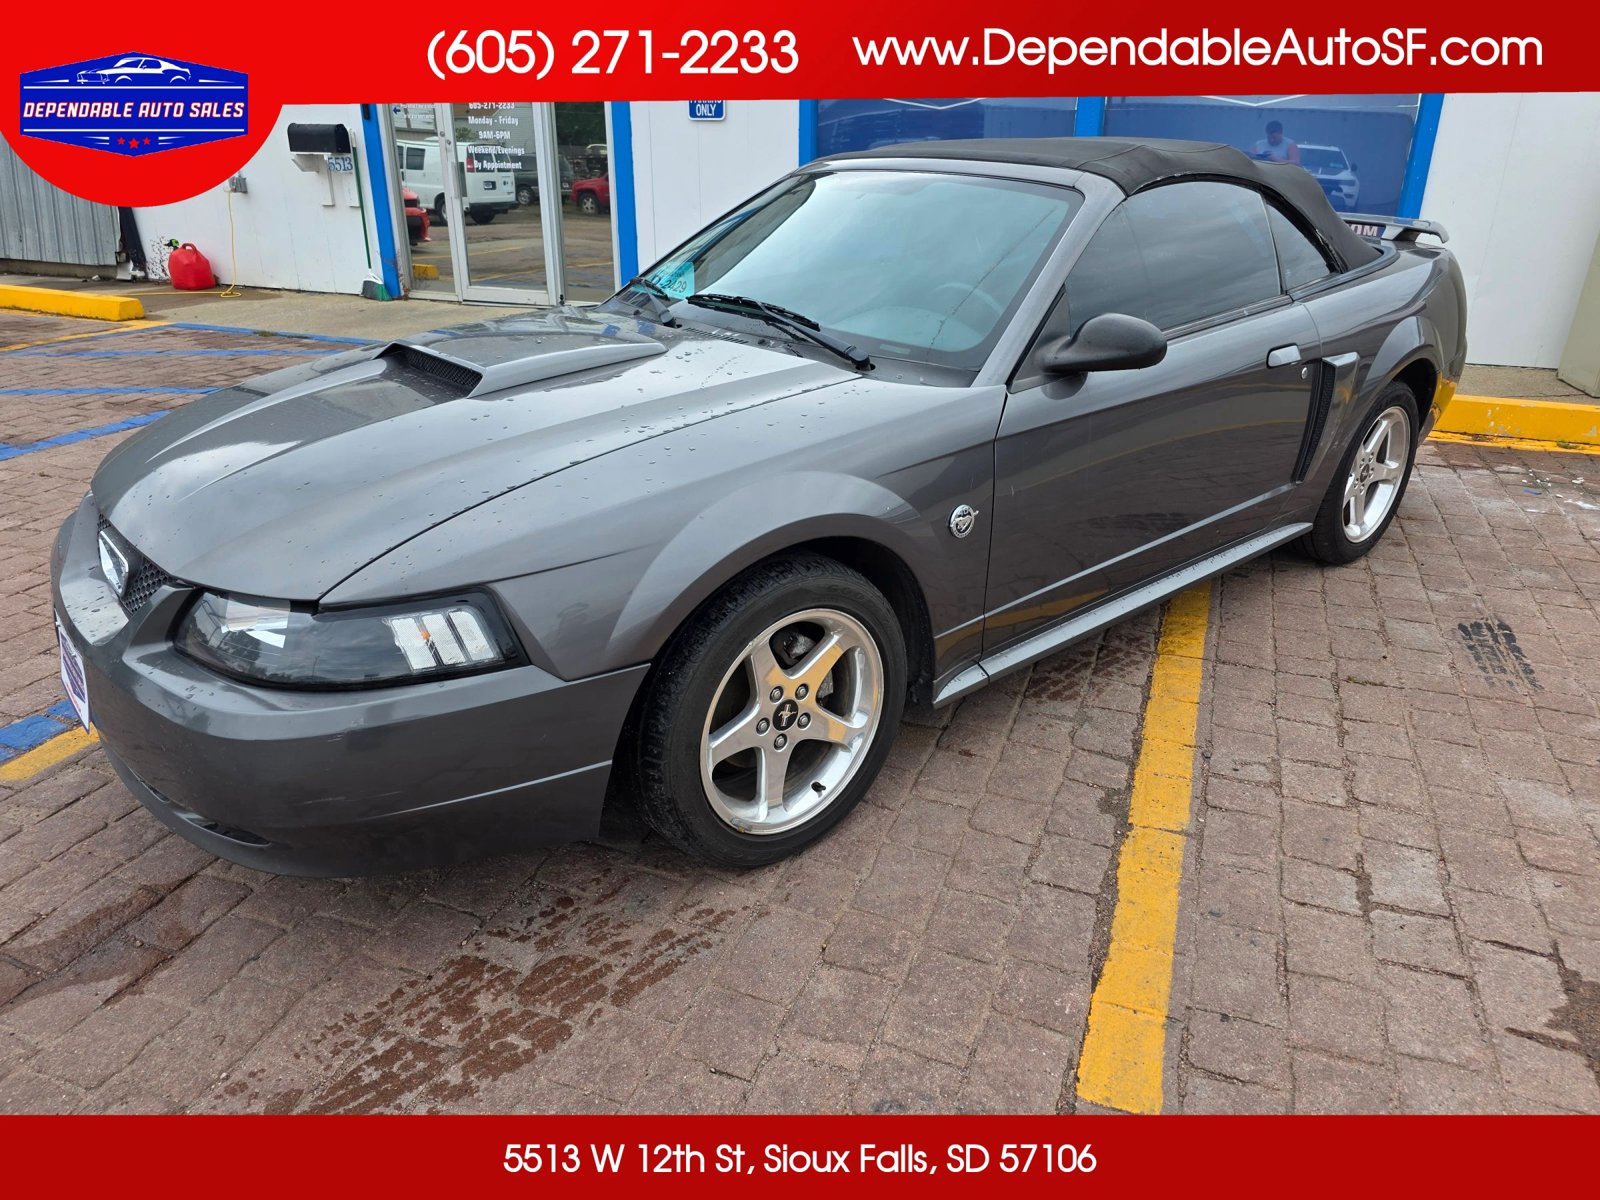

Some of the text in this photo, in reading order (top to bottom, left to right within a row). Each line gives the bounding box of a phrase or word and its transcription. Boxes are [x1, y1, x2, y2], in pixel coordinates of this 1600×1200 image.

[695, 103, 717, 116] ONLY
[468, 115, 493, 126] Monday
[498, 115, 519, 126] Friday
[478, 130, 511, 139] 9AM-6PM
[467, 145, 525, 156] Weekend/Evenings
[327, 156, 353, 171] 5513
[473, 159, 522, 170] By Appointment
